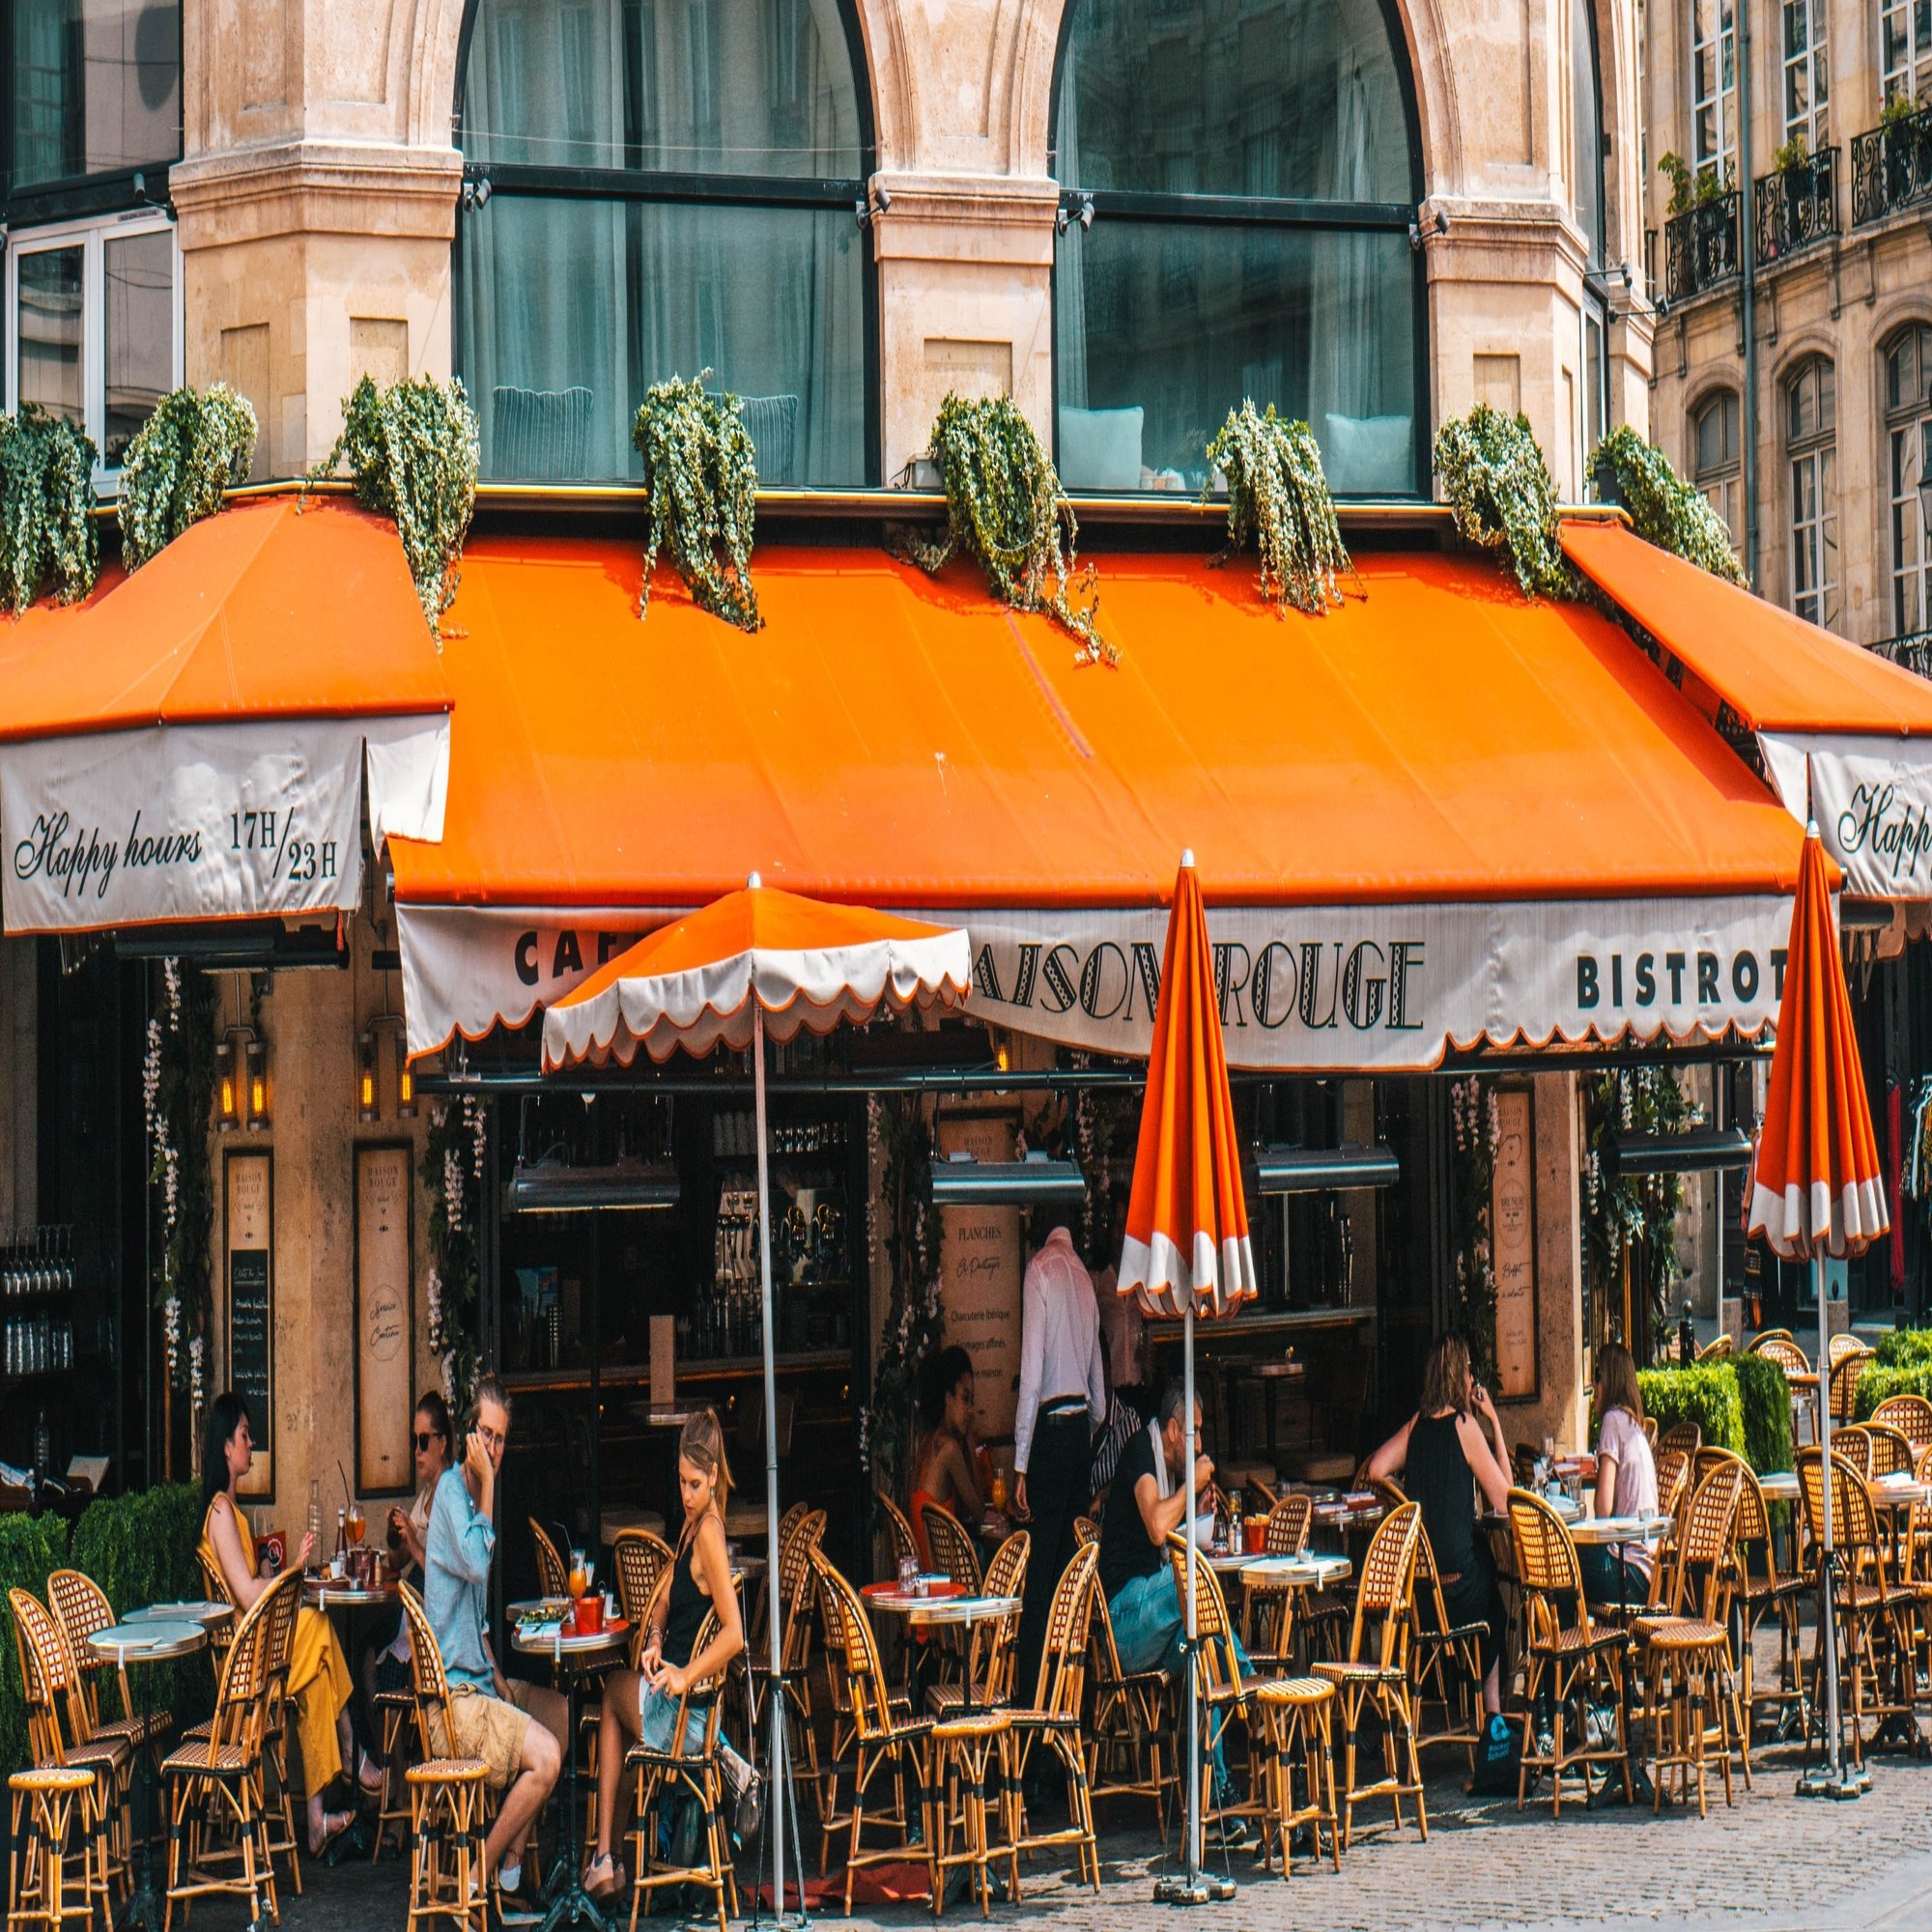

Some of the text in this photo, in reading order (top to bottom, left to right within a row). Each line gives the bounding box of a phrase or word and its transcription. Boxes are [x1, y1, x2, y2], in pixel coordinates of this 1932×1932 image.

[1838, 783, 1932, 878] Happ
[14, 811, 118, 898] Happy
[123, 810, 202, 867] hours
[515, 929, 1788, 1030] CAF AISON ROUGE BISTROT
[235, 1172, 262, 1183] MAISON
[367, 1165, 398, 1177] MAISON
[237, 1184, 260, 1195] ROUGE
[369, 1178, 397, 1188] ROUGE
[958, 1225, 1002, 1241] PLANCHES
[952, 1310, 985, 1323] Charcuterie
